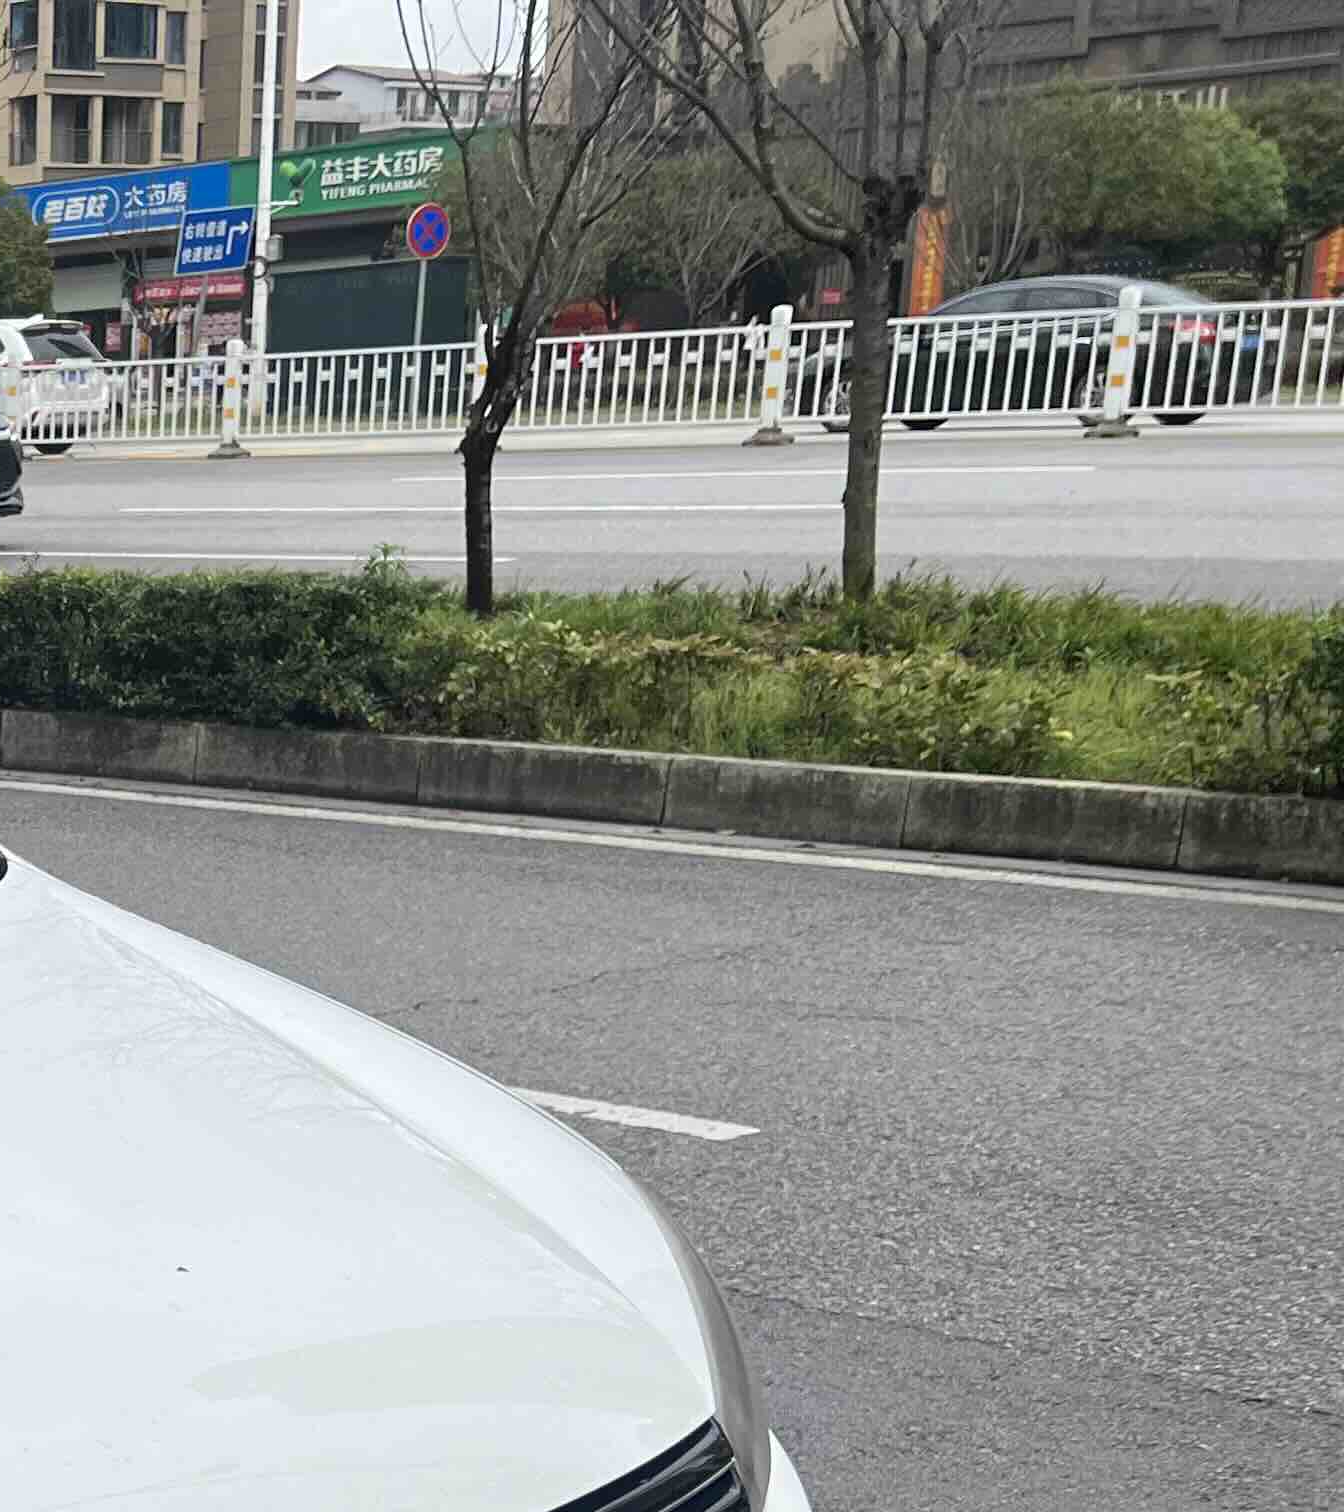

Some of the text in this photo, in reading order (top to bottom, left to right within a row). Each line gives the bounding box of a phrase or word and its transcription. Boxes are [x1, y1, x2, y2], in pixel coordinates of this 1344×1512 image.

[320, 145, 444, 187] 益丰大药房
[123, 180, 188, 209] 大药房
[321, 183, 364, 201] YIFENG
